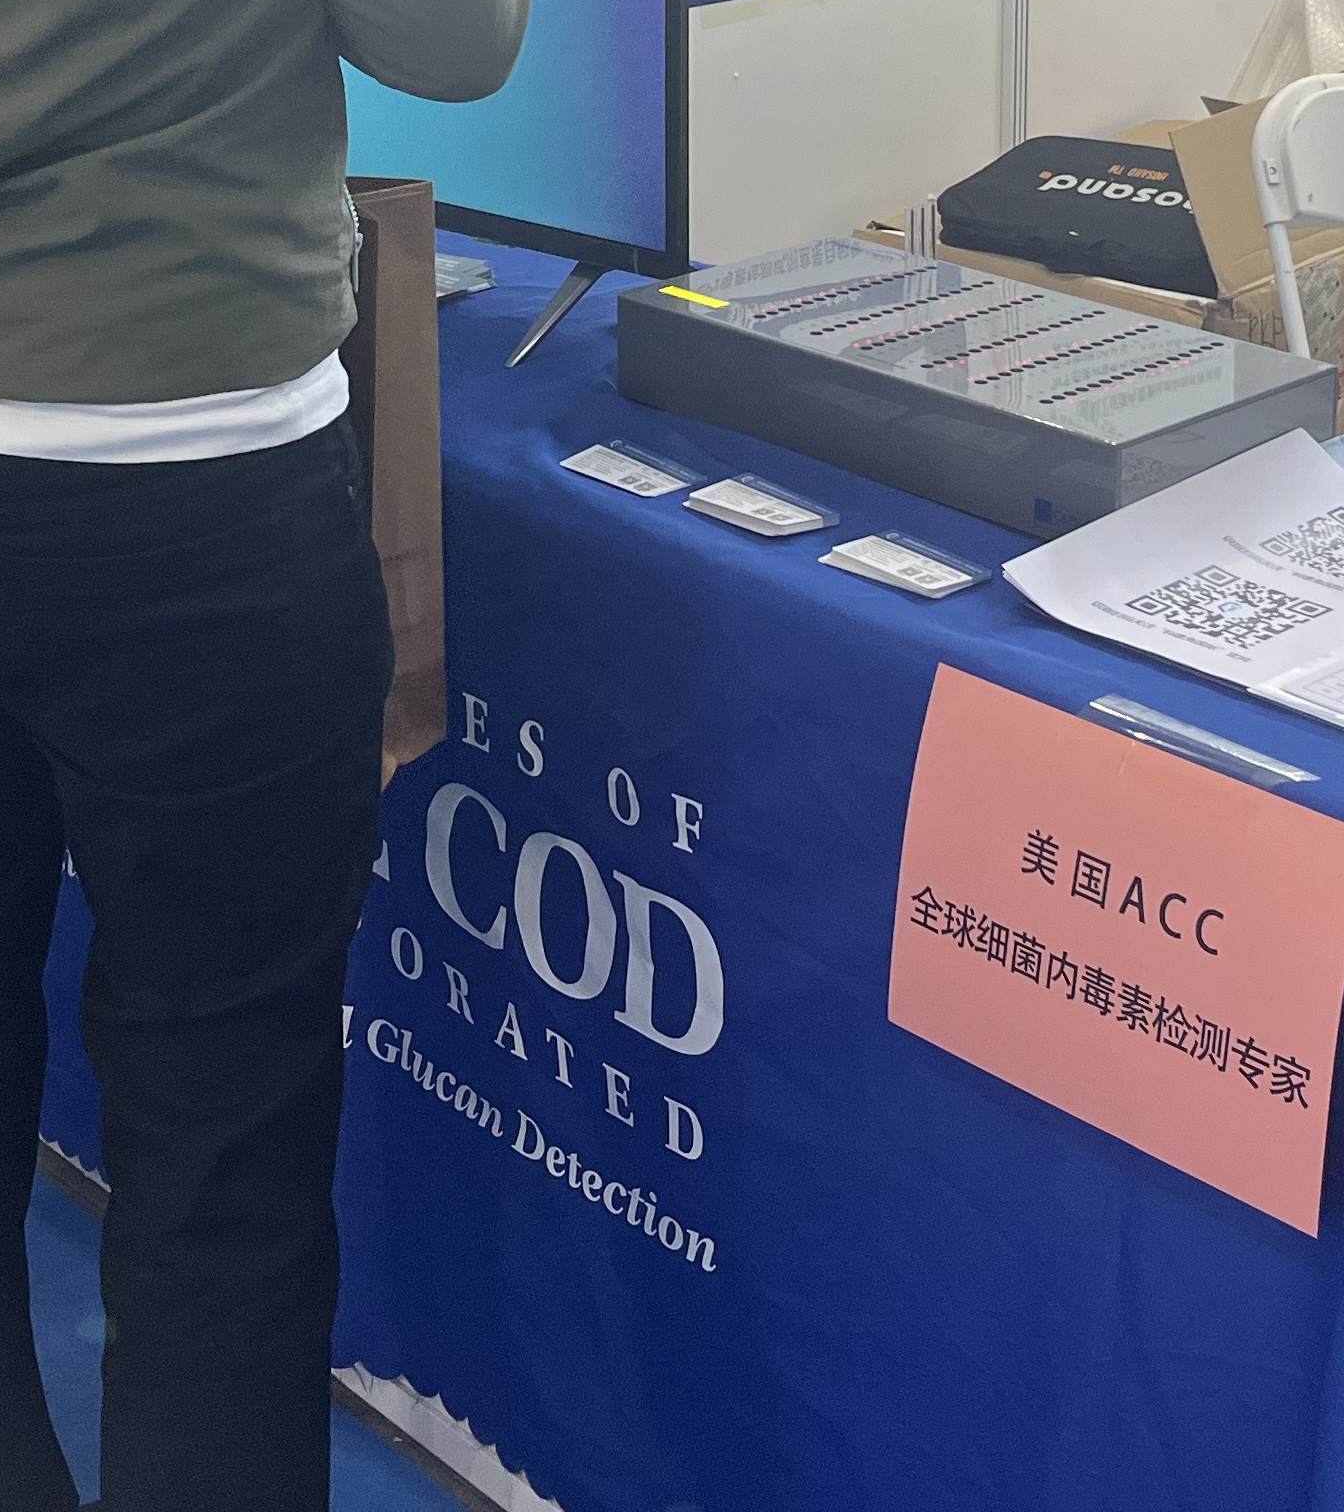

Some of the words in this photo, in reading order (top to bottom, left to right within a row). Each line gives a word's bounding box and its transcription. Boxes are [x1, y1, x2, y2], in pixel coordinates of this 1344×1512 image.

[425, 783, 725, 1056] COD
[607, 767, 704, 853] OF
[1020, 829, 1225, 957] 美国ACC
[390, 927, 705, 1161] ORATED
[910, 886, 1312, 1111] 全球细菌内毒素检测专家
[367, 1018, 503, 1138] Glucan
[511, 1109, 718, 1273] Detection
